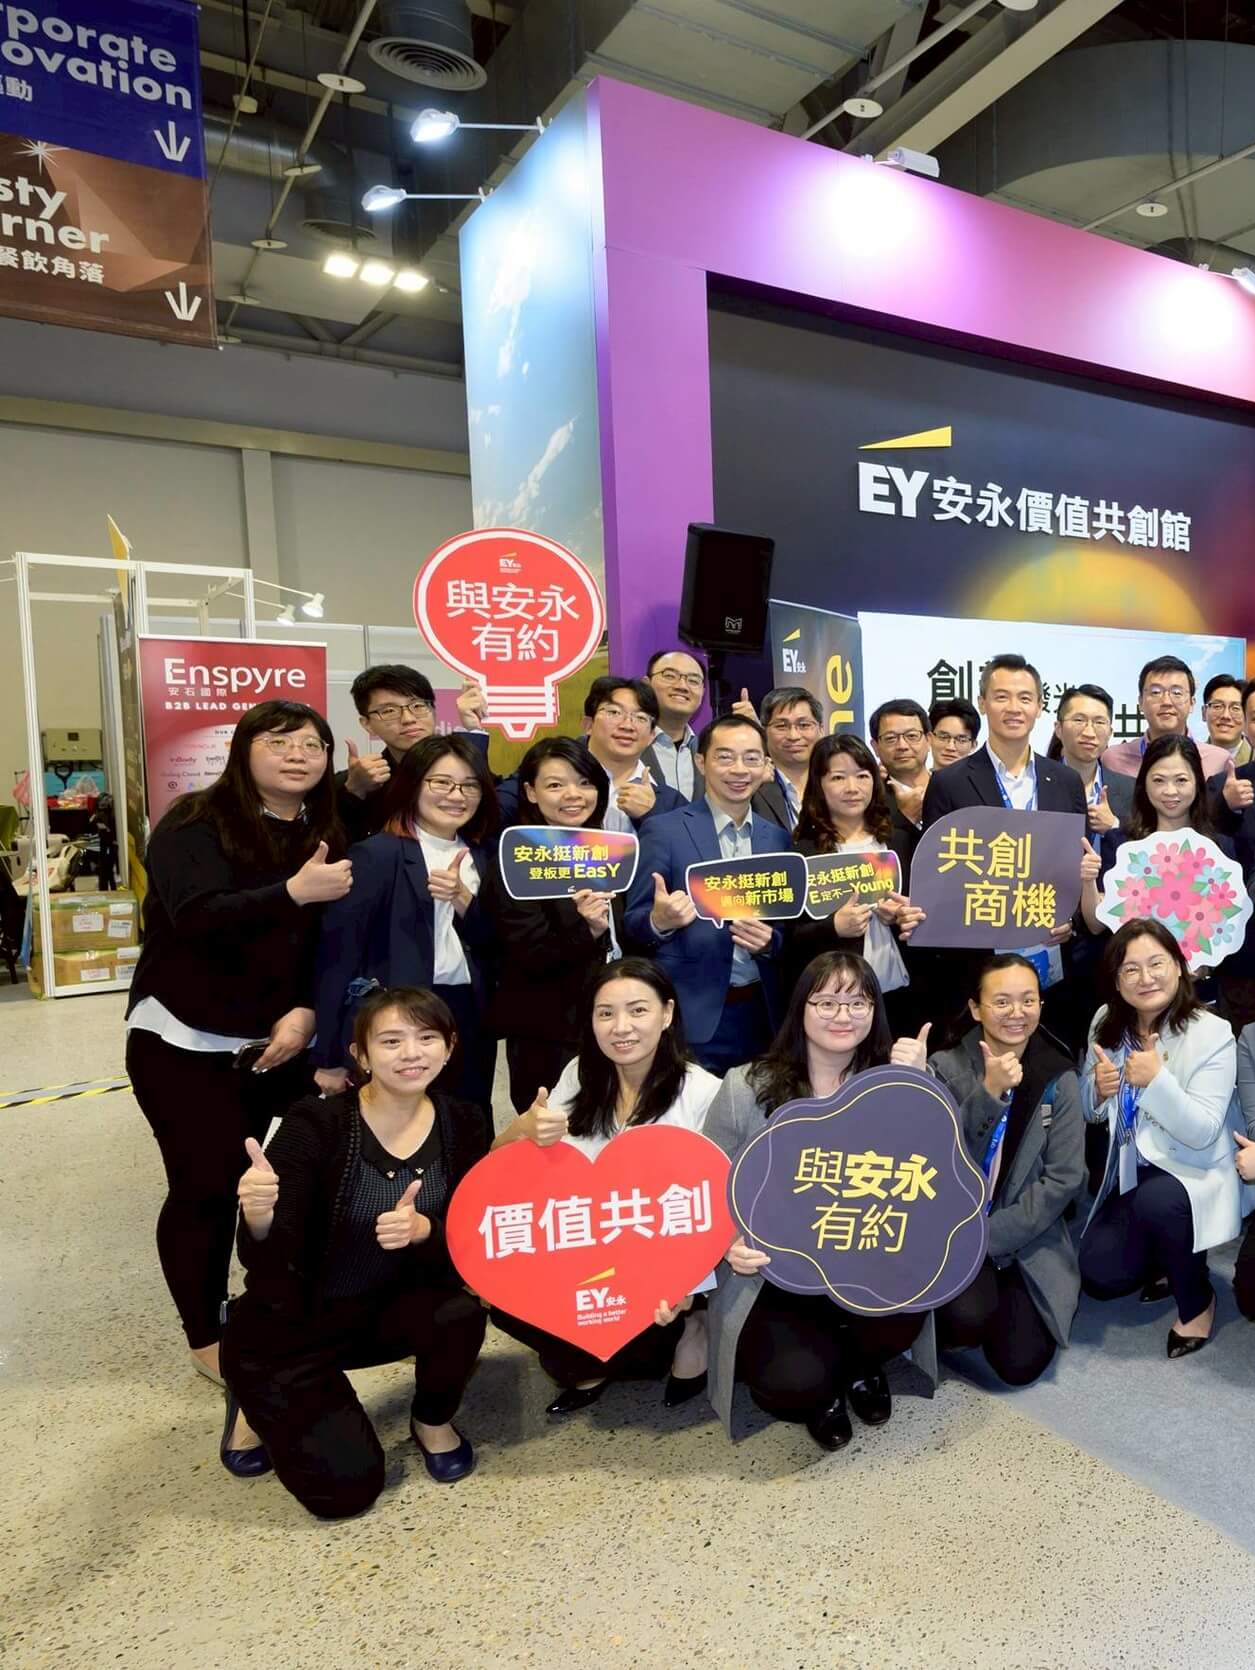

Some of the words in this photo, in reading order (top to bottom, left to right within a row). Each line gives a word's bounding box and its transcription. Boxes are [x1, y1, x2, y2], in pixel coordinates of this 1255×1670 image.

[0, 3, 177, 73] porate
[858, 461, 930, 518] EY
[932, 476, 1192, 552] 安永價值共創館
[446, 579, 580, 621] 與安永
[472, 622, 559, 662] 有約
[782, 647, 799, 673] EY
[165, 658, 306, 693] Enspyre
[165, 702, 191, 710] B2B
[196, 702, 227, 710] LEAD
[513, 845, 609, 863] 安永挺新創
[574, 863, 621, 879] EasY
[937, 827, 1032, 879] 共創
[704, 870, 788, 891] 安永挺新創
[963, 879, 1056, 929] 商機
[792, 1147, 938, 1202] 與安永
[478, 1180, 713, 1260] 價值共創
[811, 1202, 908, 1252] 有約
[576, 1287, 609, 1311] EY
